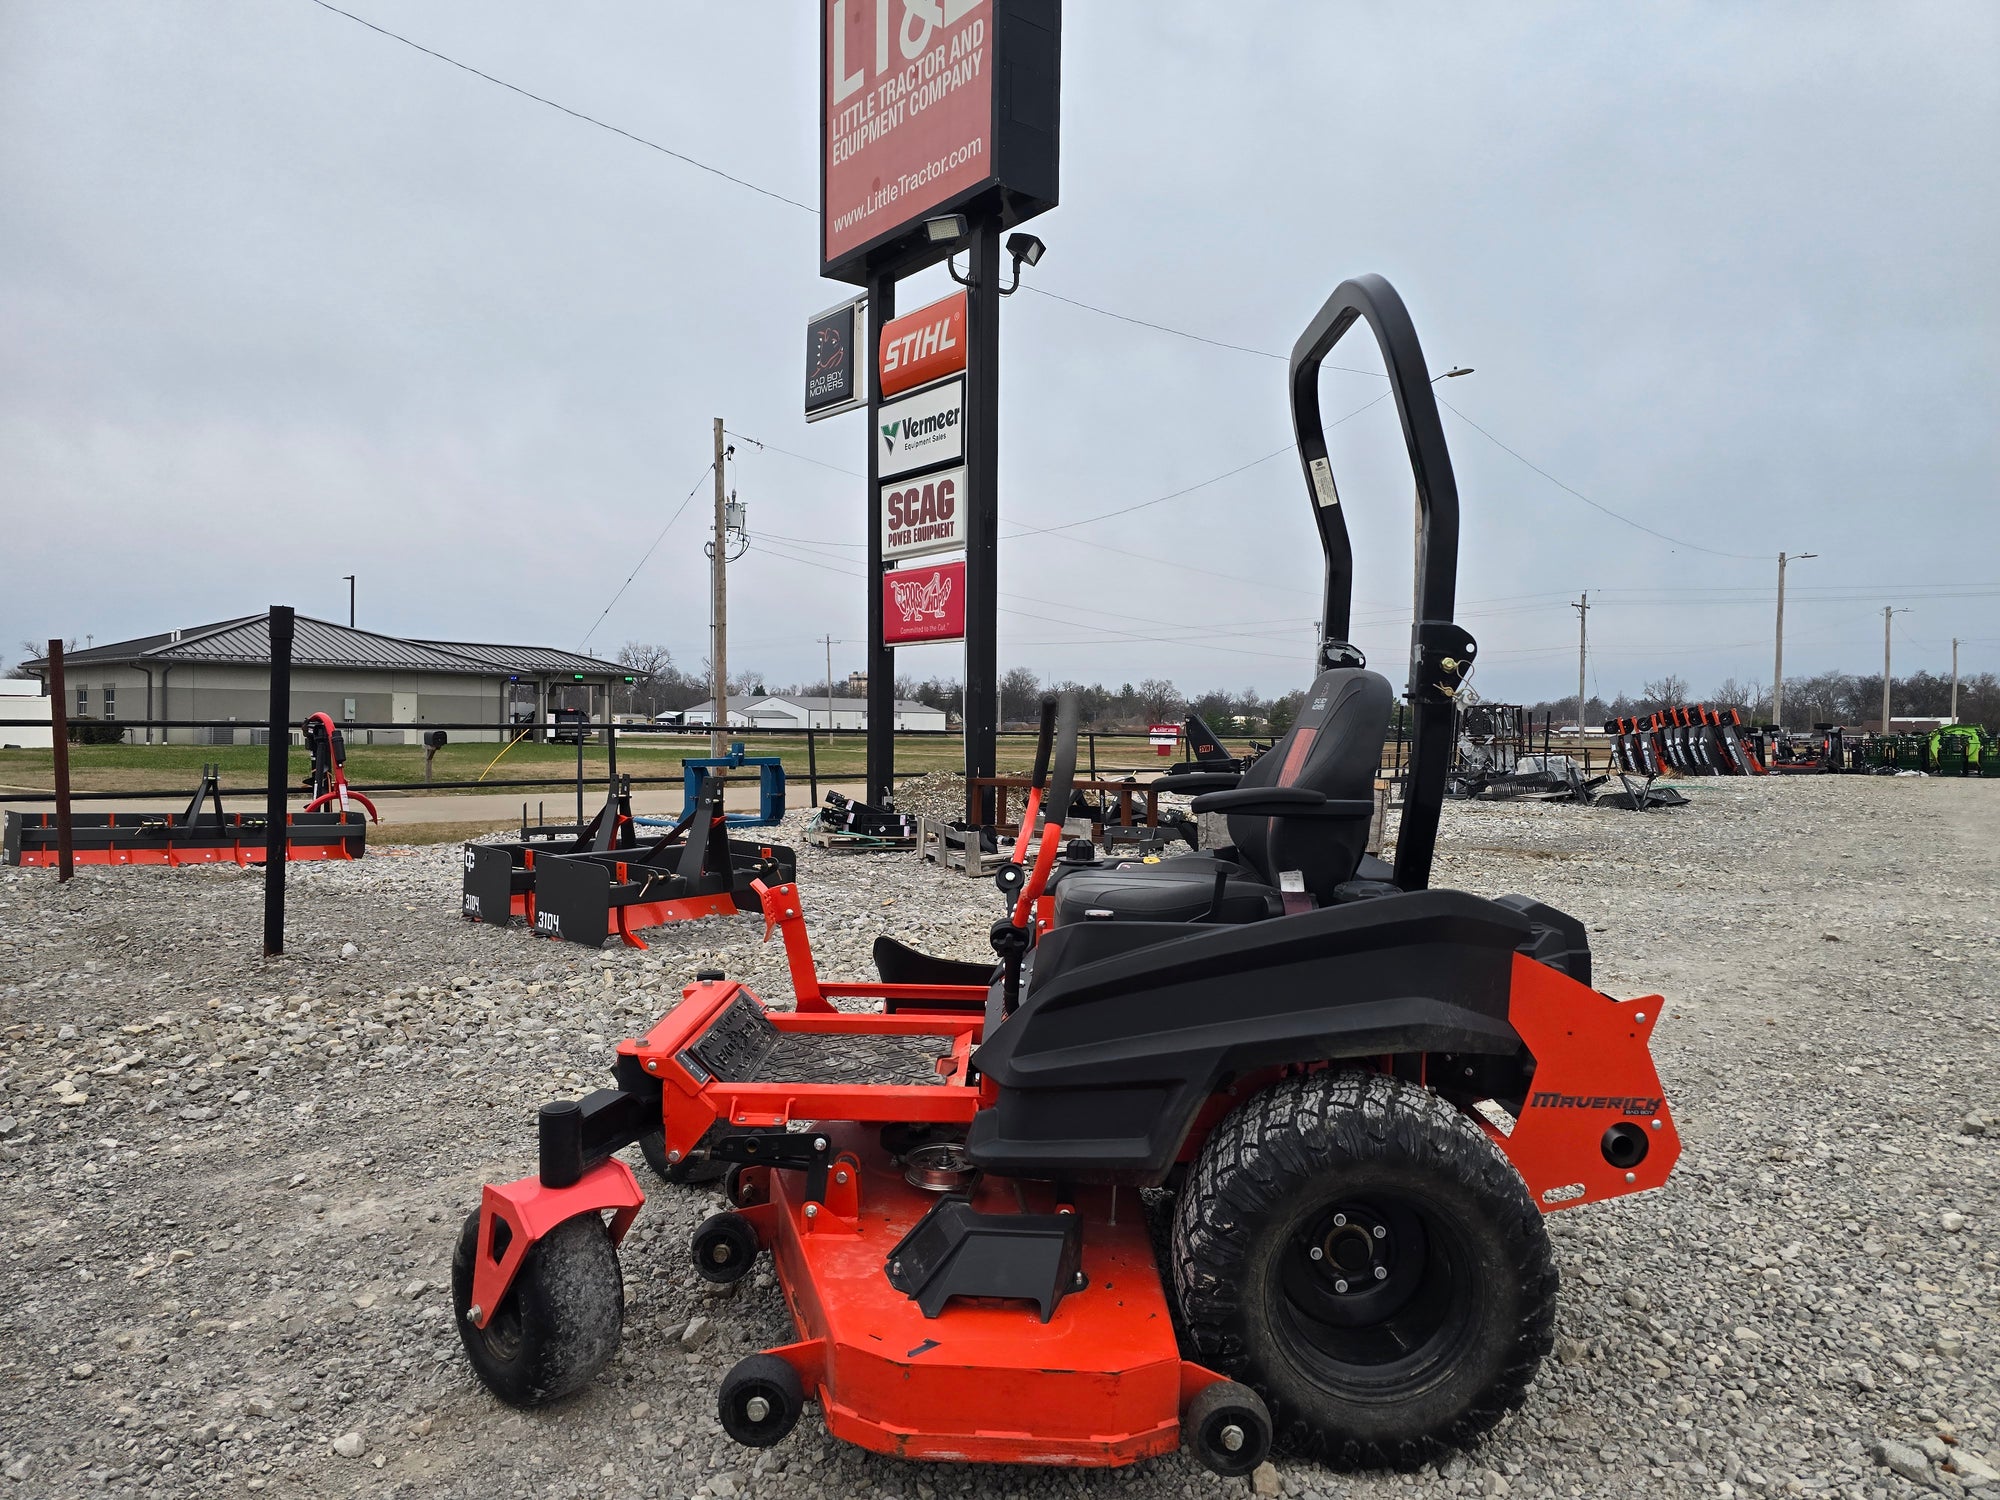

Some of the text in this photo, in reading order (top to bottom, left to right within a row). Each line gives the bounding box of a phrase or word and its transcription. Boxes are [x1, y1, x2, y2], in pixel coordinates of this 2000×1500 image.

[832, 18, 985, 142] LITTLE TRACTOR AND
[832, 47, 984, 167] EQUIPMENT COMPANY
[833, 136, 983, 234] www.LittleTractor.com
[883, 316, 957, 373] STIHL
[809, 378, 844, 398] MOWERS
[810, 370, 843, 389] BAD BOY
[902, 407, 960, 440] Vermeer
[904, 432, 947, 451] Equipment Sales
[888, 478, 955, 531] SCAG
[888, 521, 954, 548] POWER EQUIPMENT
[465, 893, 480, 912] 3104
[538, 911, 560, 932] 3104
